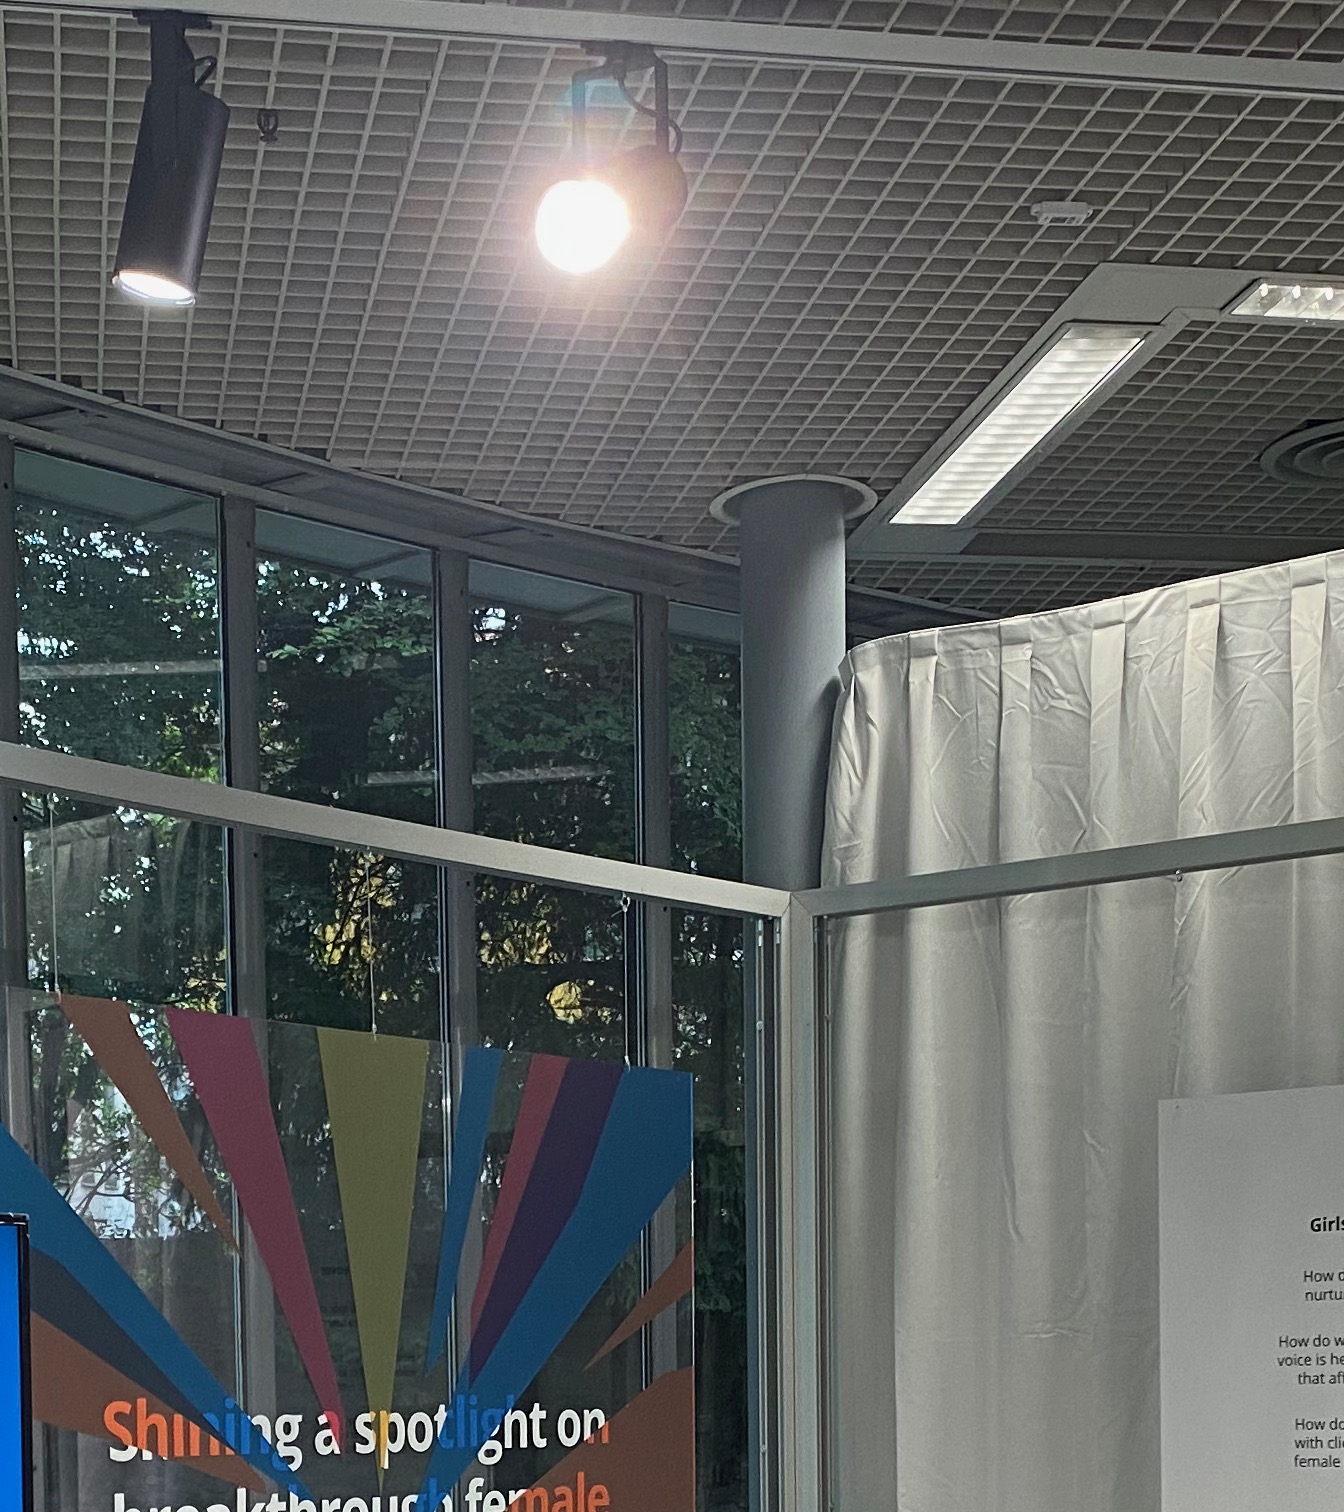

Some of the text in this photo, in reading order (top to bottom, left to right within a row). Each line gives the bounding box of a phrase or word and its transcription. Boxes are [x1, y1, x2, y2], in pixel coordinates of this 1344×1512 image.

[1303, 1269, 1334, 1283] How
[1278, 1335, 1309, 1348] How
[1313, 1334, 1331, 1347] do
[1277, 1353, 1312, 1366] voice
[1316, 1353, 1327, 1365] is
[1298, 1371, 1325, 1385] that
[1294, 1417, 1326, 1430] How
[104, 1393, 610, 1472] Shining a spotlight on
[1294, 1436, 1324, 1449] with
[1293, 1454, 1341, 1468] female
